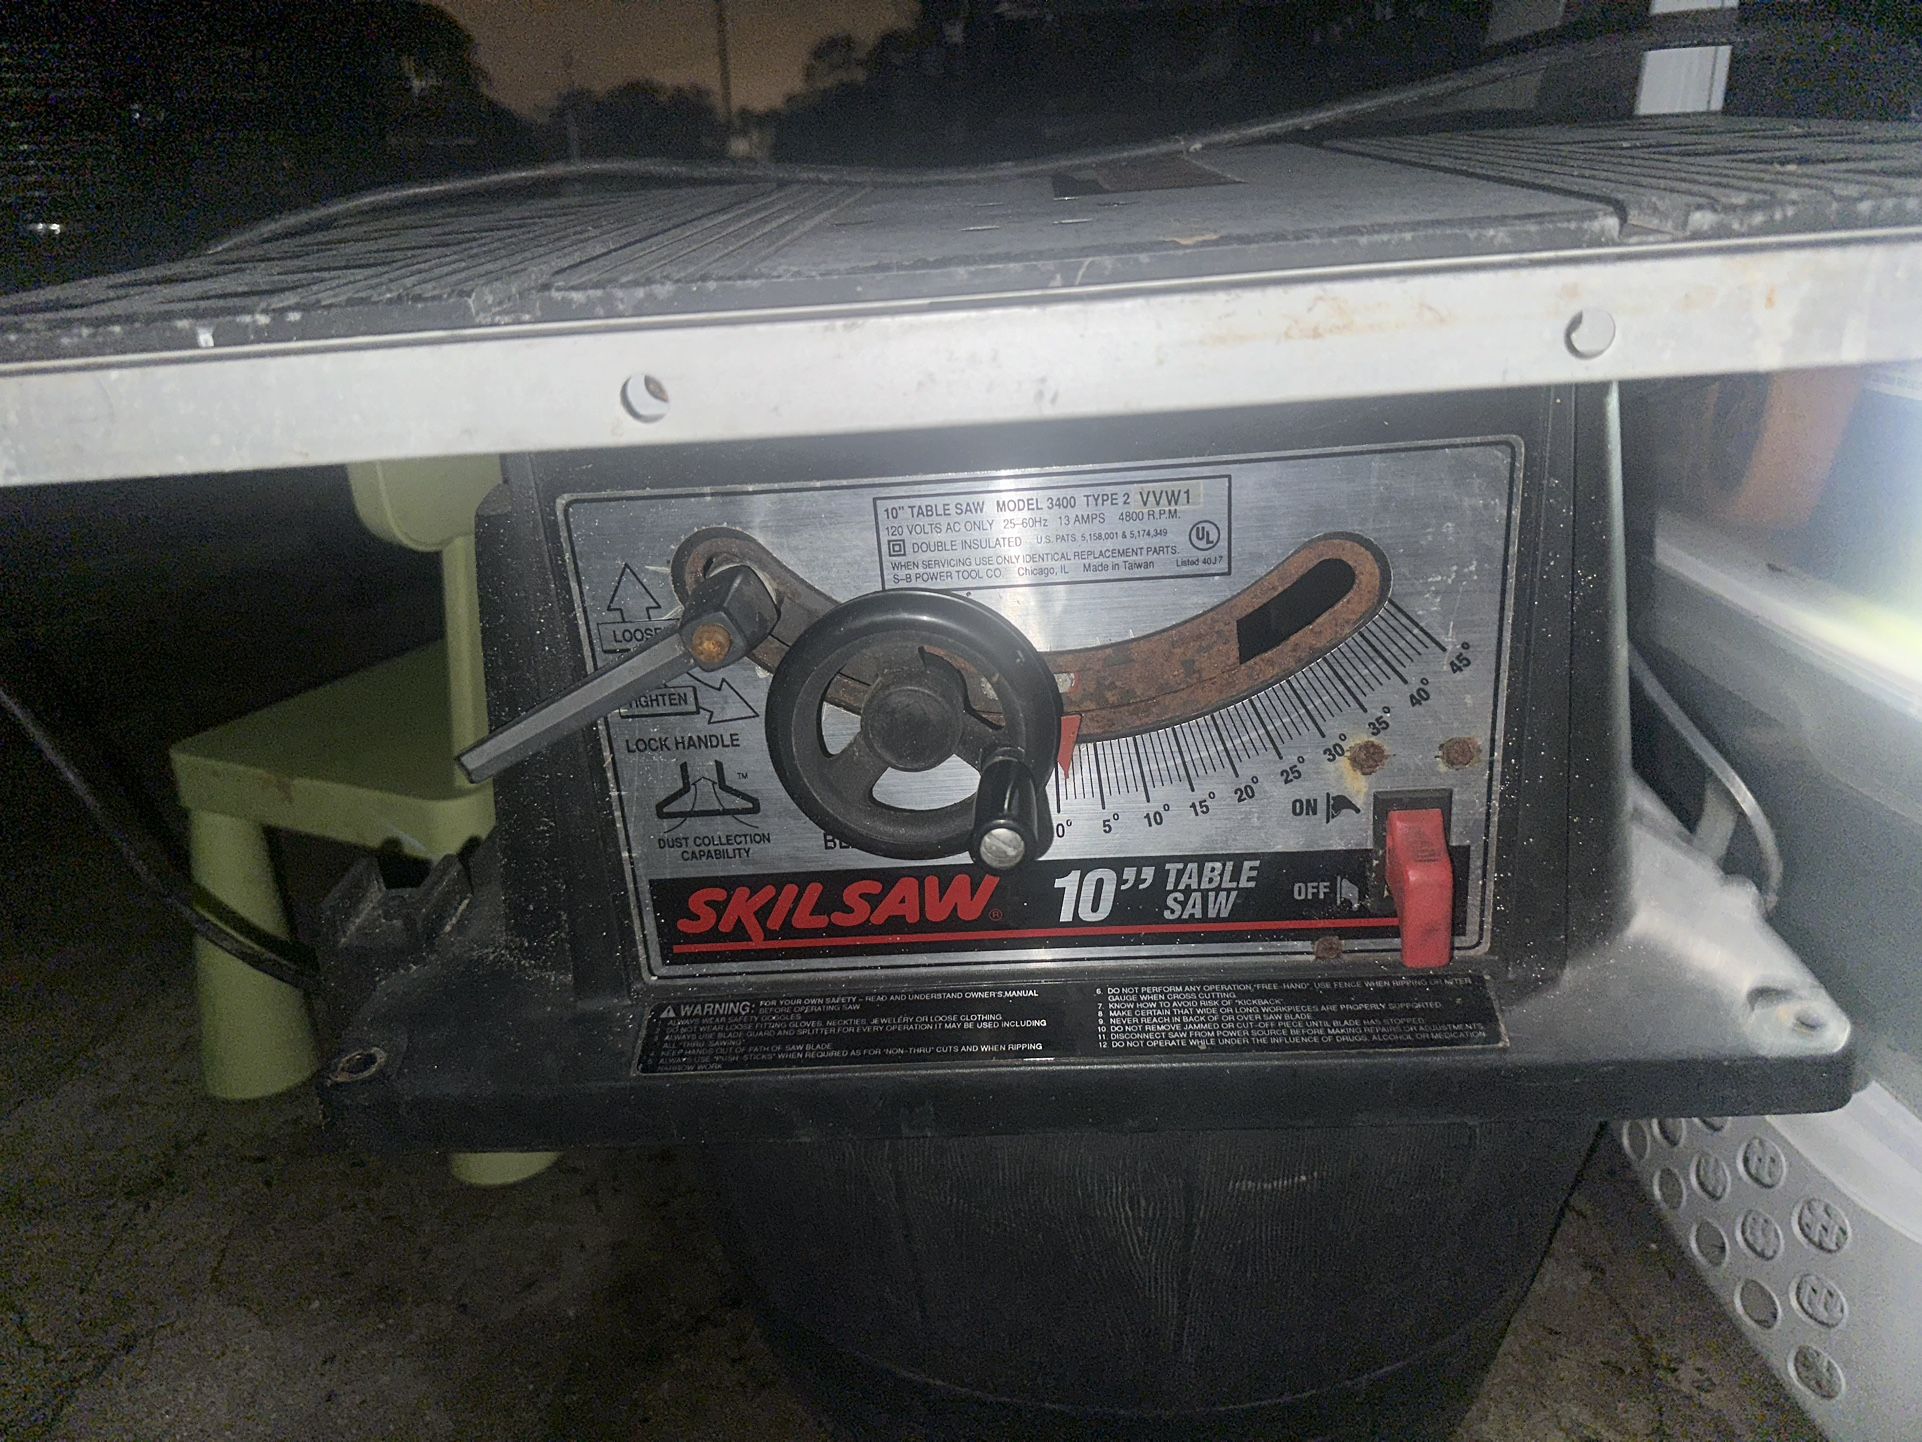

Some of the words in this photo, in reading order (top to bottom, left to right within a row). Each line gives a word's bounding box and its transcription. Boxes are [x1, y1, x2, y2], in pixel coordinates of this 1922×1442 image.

[884, 506, 904, 520] 10"
[909, 504, 951, 518] TABLE
[955, 501, 984, 515] SAW
[996, 498, 1043, 512] MODEL
[1047, 496, 1076, 510] 3400
[1084, 493, 1118, 507] TYPE
[1122, 492, 1130, 505] 2
[1140, 488, 1190, 506] VVW1
[886, 526, 903, 537] 120
[907, 522, 942, 536] VOLTS
[946, 522, 961, 533] AC
[964, 520, 994, 532] ONLY
[1058, 516, 1070, 526] 13
[1074, 513, 1106, 524] AMPS
[1118, 510, 1144, 522] 4800
[1148, 508, 1180, 520] R.P.M.
[912, 540, 958, 554] DOUBLE
[961, 536, 1022, 550] INSULATED
[1036, 535, 1054, 544] U.S.
[1122, 530, 1127, 539] &
[891, 560, 919, 571] WHEN
[922, 557, 972, 570] SERVICING
[975, 556, 994, 566] USE
[996, 554, 1020, 565] ONLY
[1022, 550, 1071, 563] IDENTICAL
[1074, 547, 1143, 560] REPLACEMENT
[1146, 546, 1179, 556] PARTS.
[1176, 558, 1199, 567] Listed
[915, 570, 953, 583] POWER
[956, 568, 983, 580] TOOL
[1018, 565, 1058, 578] Chicago,
[1060, 564, 1069, 574] IL
[1083, 562, 1109, 573] Made
[1112, 561, 1120, 571] in
[1123, 559, 1155, 570] Taiwan
[613, 628, 662, 643] LOOS
[626, 737, 670, 753] LOCK
[675, 733, 741, 750] HANDLE
[1291, 798, 1318, 817] ON
[658, 836, 689, 849] DUST
[693, 833, 771, 847] COLLECTION
[681, 848, 751, 862] CAPABILITY
[1165, 860, 1260, 890] TABLE
[1294, 881, 1330, 901] OFF
[676, 873, 1000, 944] SKILSAW
[1163, 890, 1238, 920] SAW
[908, 992, 962, 1000] UNDERSTAND
[680, 1002, 755, 1016] WARNING:
[1111, 1032, 1166, 1040] DISCONNECT
